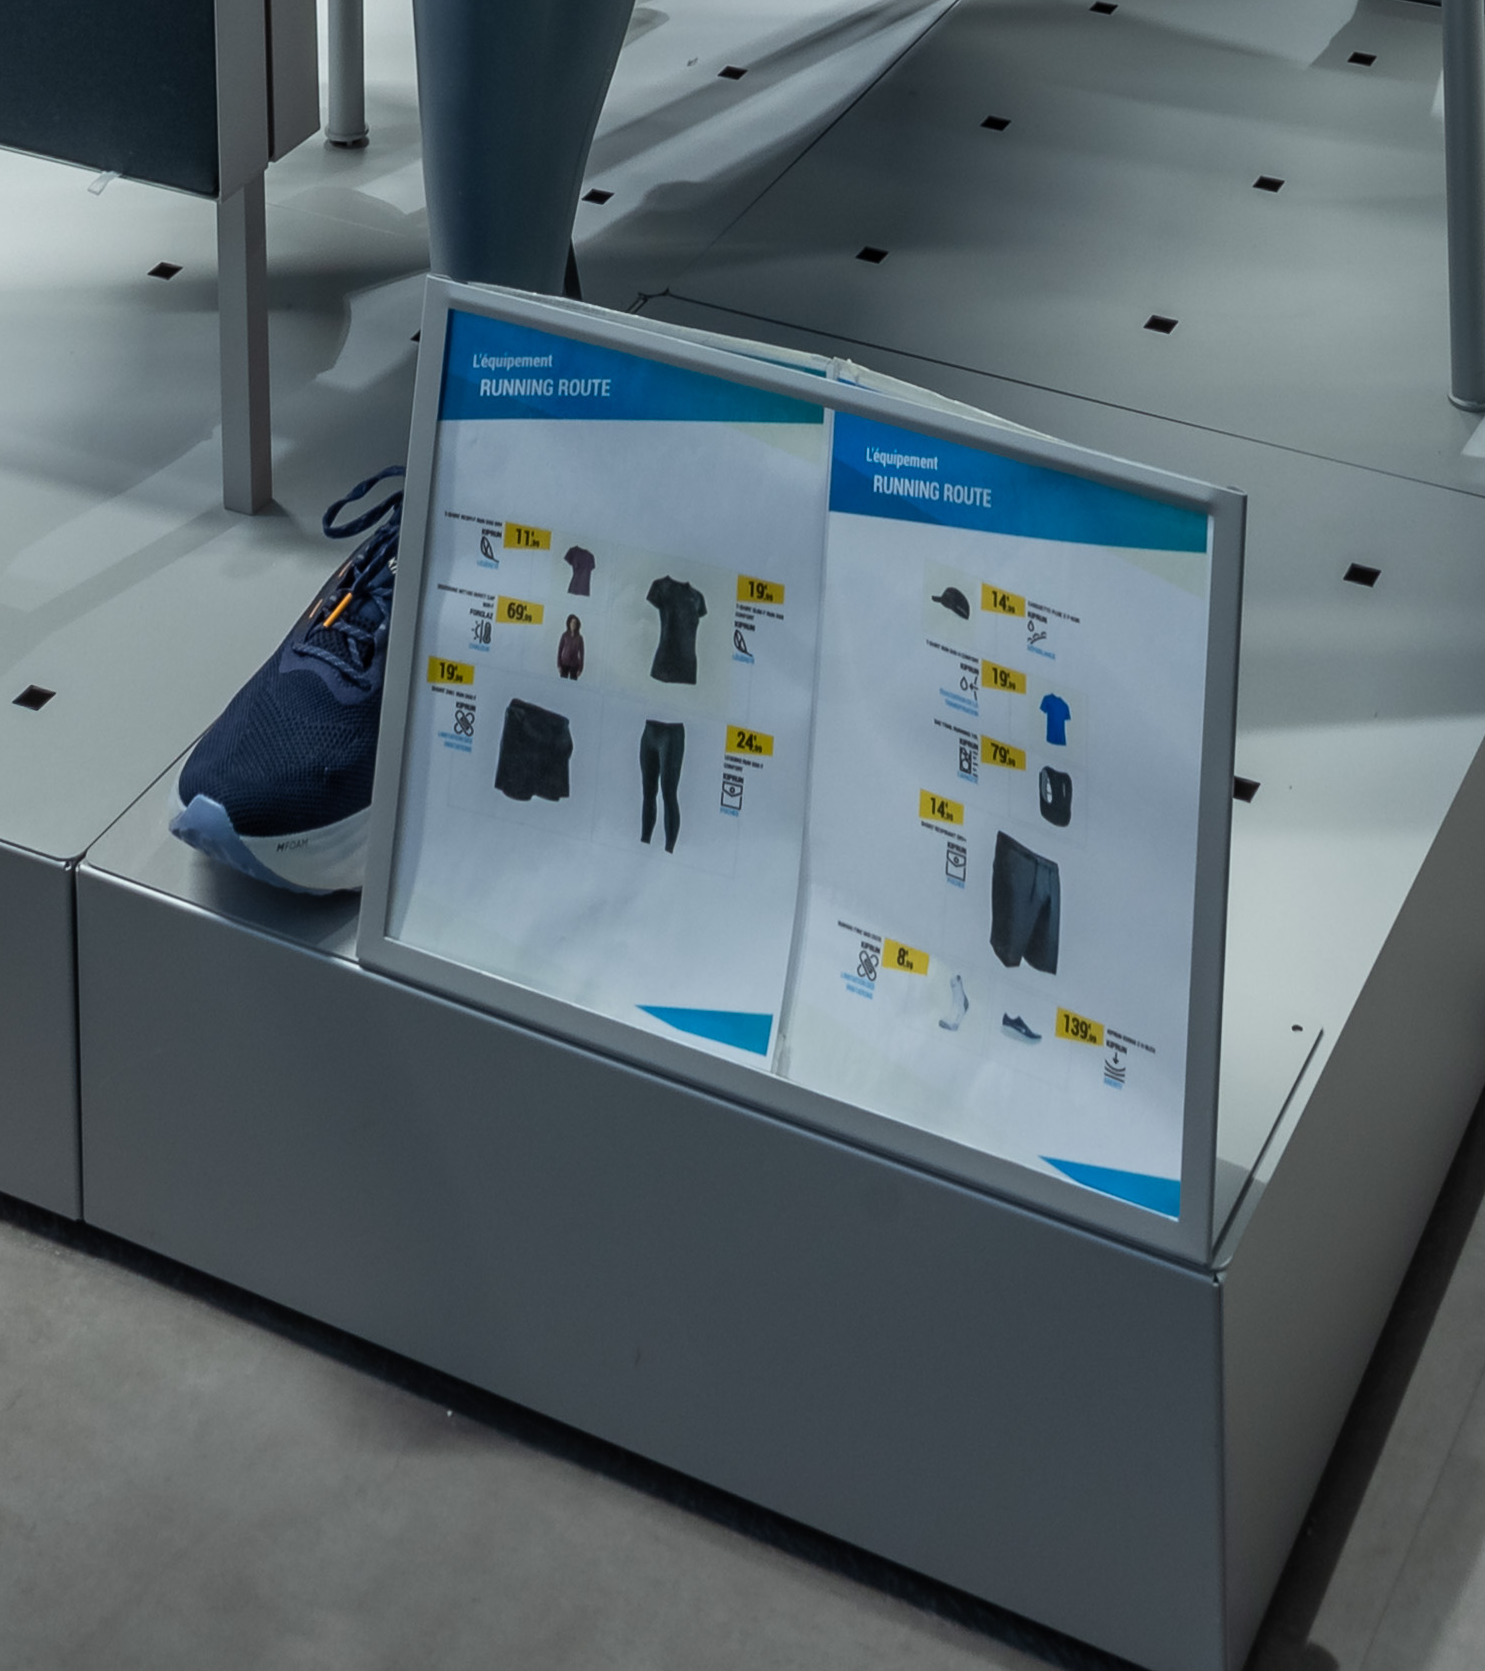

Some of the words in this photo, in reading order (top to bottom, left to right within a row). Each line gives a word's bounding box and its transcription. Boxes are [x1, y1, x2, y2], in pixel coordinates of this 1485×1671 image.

[472, 353, 553, 372] L'équipement
[479, 378, 554, 397] RUNNING
[557, 379, 611, 397] ROUTE
[866, 447, 938, 471] L'équipement
[873, 474, 940, 500] RUNNING
[943, 483, 992, 508] ROUTE
